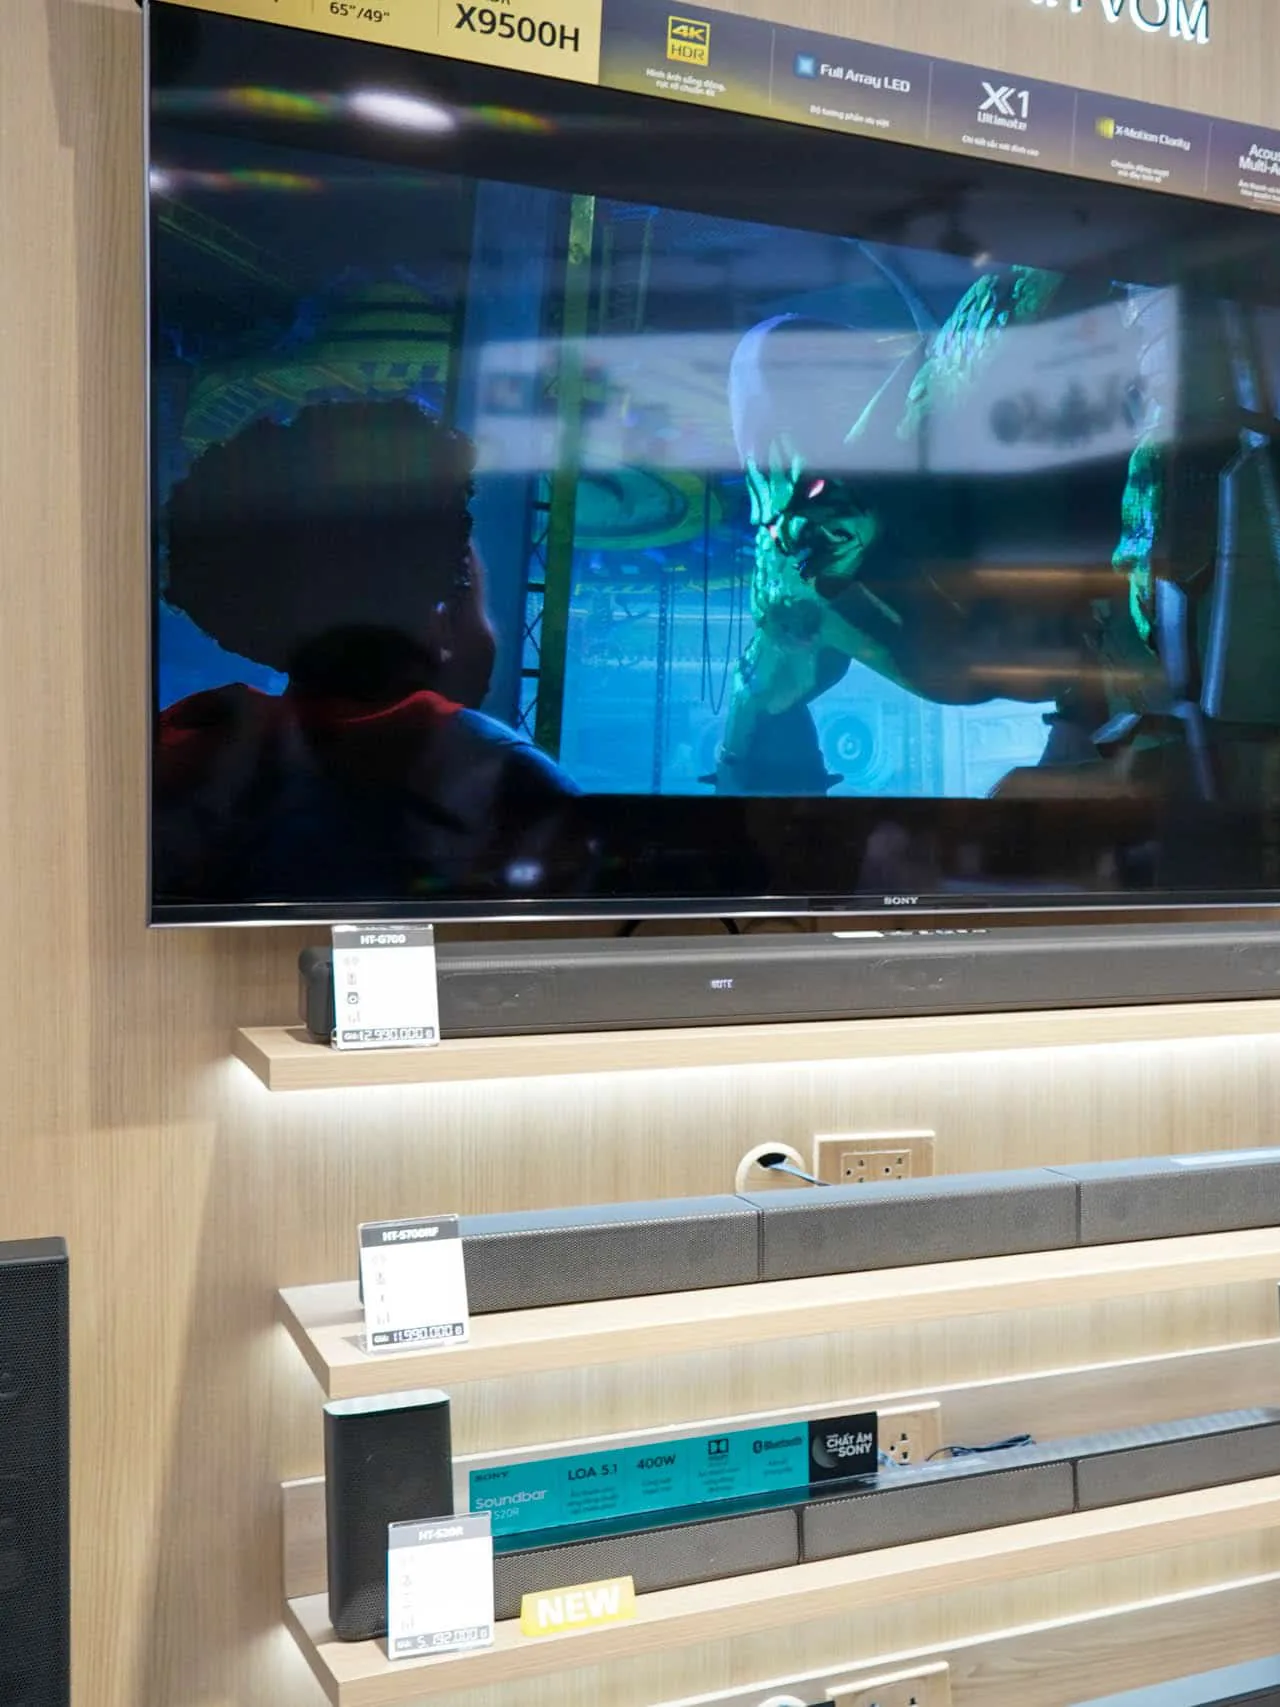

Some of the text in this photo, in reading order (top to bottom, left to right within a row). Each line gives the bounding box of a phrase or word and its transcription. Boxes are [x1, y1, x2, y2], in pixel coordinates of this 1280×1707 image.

[455, 3, 580, 52] X9500H
[671, 24, 705, 42] 4K
[671, 44, 705, 61] HDR
[820, 64, 911, 93] Full Array LED
[977, 111, 1028, 132] Ultimate
[1159, 134, 1191, 152] Clarity
[884, 896, 918, 906] SONY
[360, 933, 407, 945] HT-G700
[838, 1443, 873, 1457] SONY
[637, 1454, 676, 1469] 400W
[475, 1471, 509, 1483] SONY
[568, 1464, 618, 1481] LOA 5.1
[475, 1490, 548, 1510] Soundbar
[536, 1585, 622, 1629] NEW
